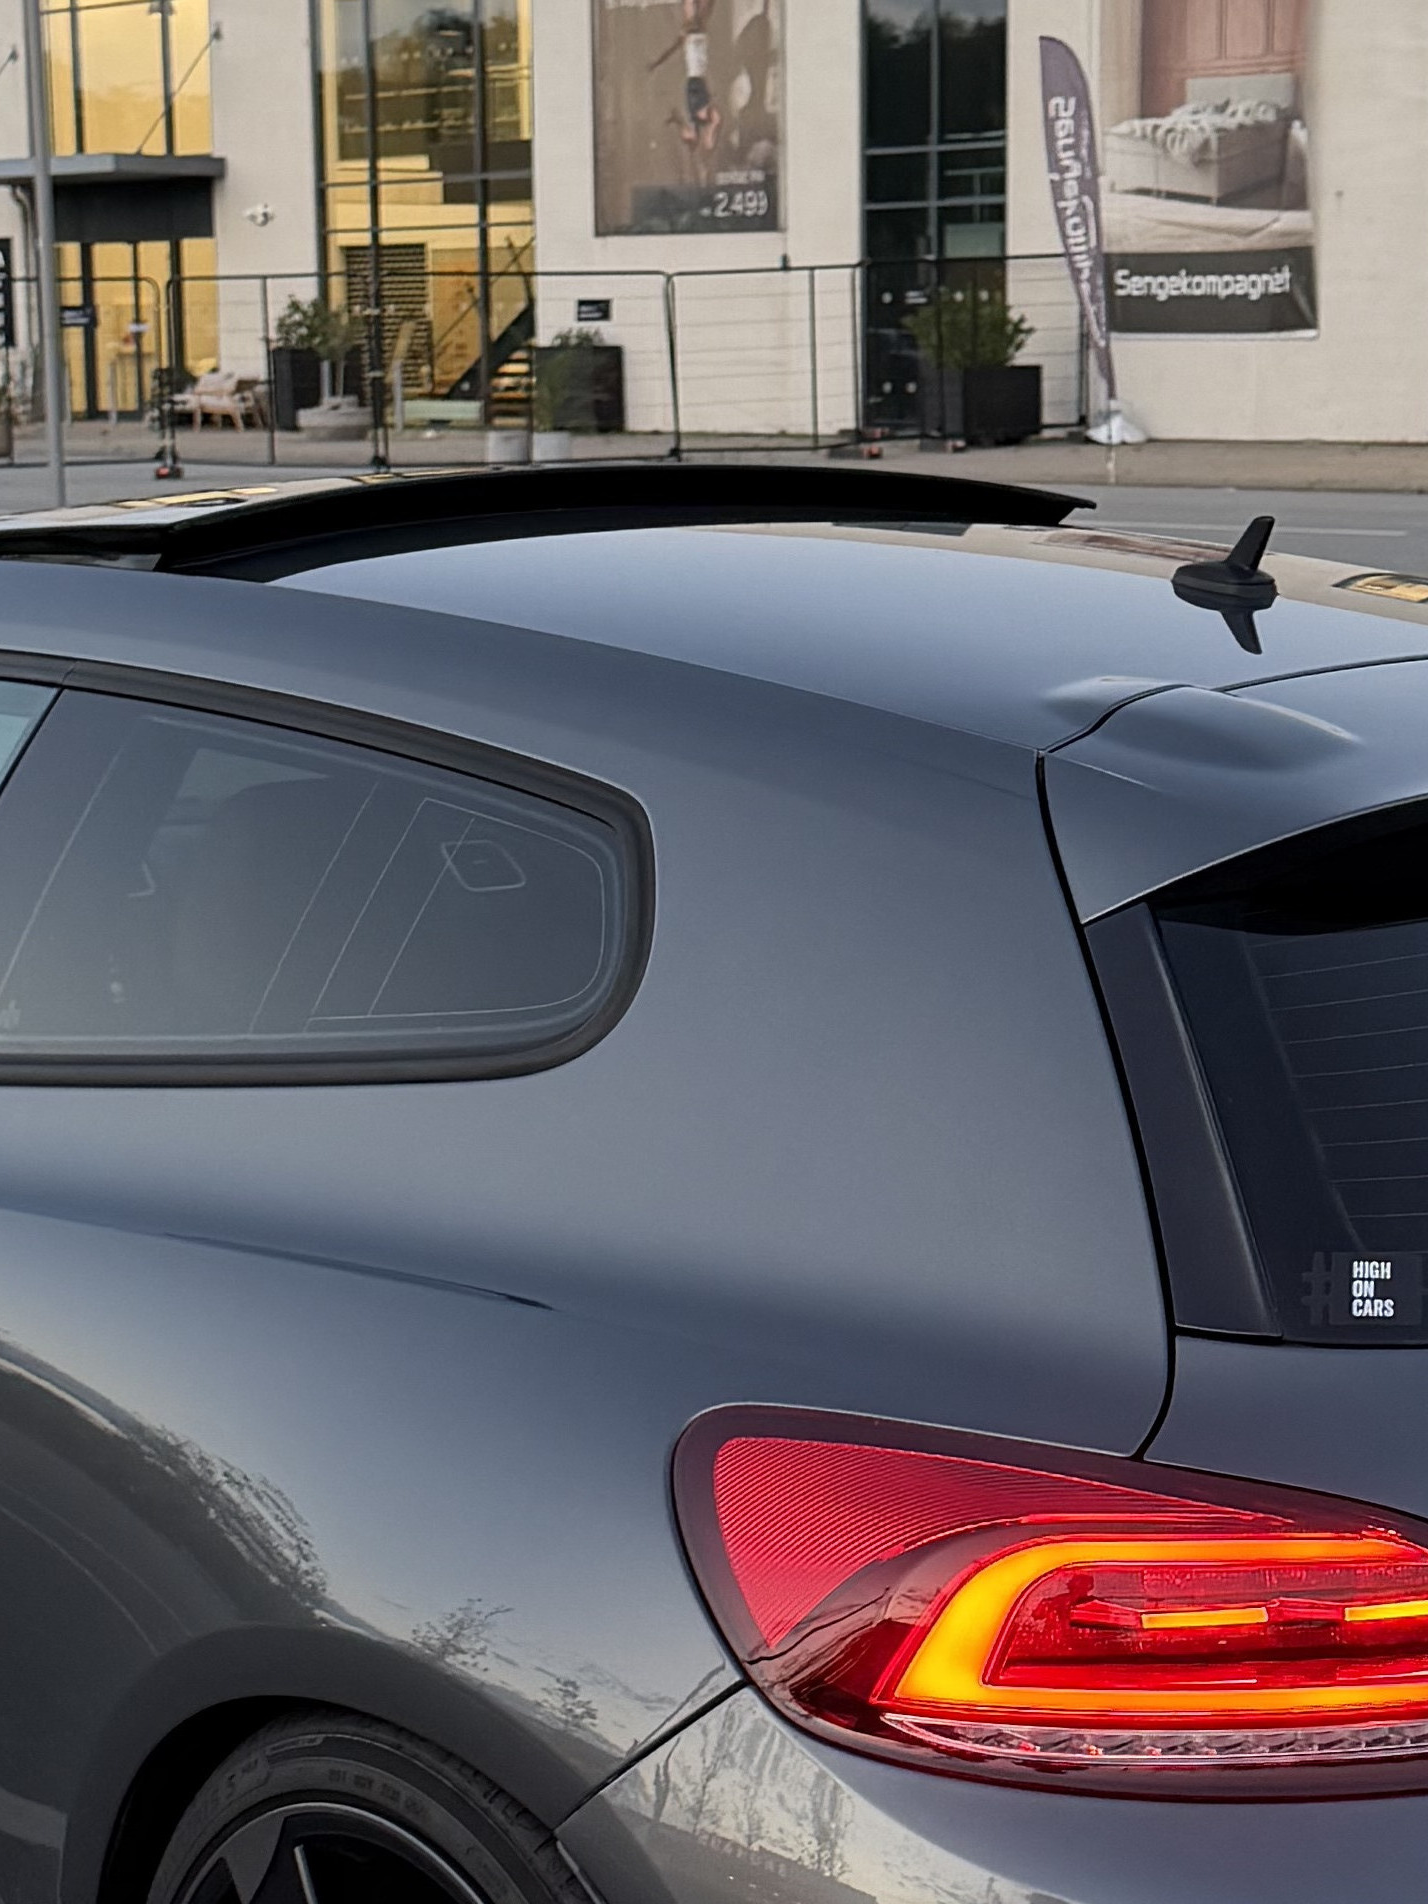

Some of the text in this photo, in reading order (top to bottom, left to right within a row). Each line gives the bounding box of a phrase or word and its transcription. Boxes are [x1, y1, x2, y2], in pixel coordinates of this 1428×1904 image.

[1114, 265, 1291, 302] Sengekompagniet
[1351, 1260, 1392, 1280] HIGH
[1351, 1279, 1375, 1298] ON
[1351, 1298, 1395, 1318] CARS
